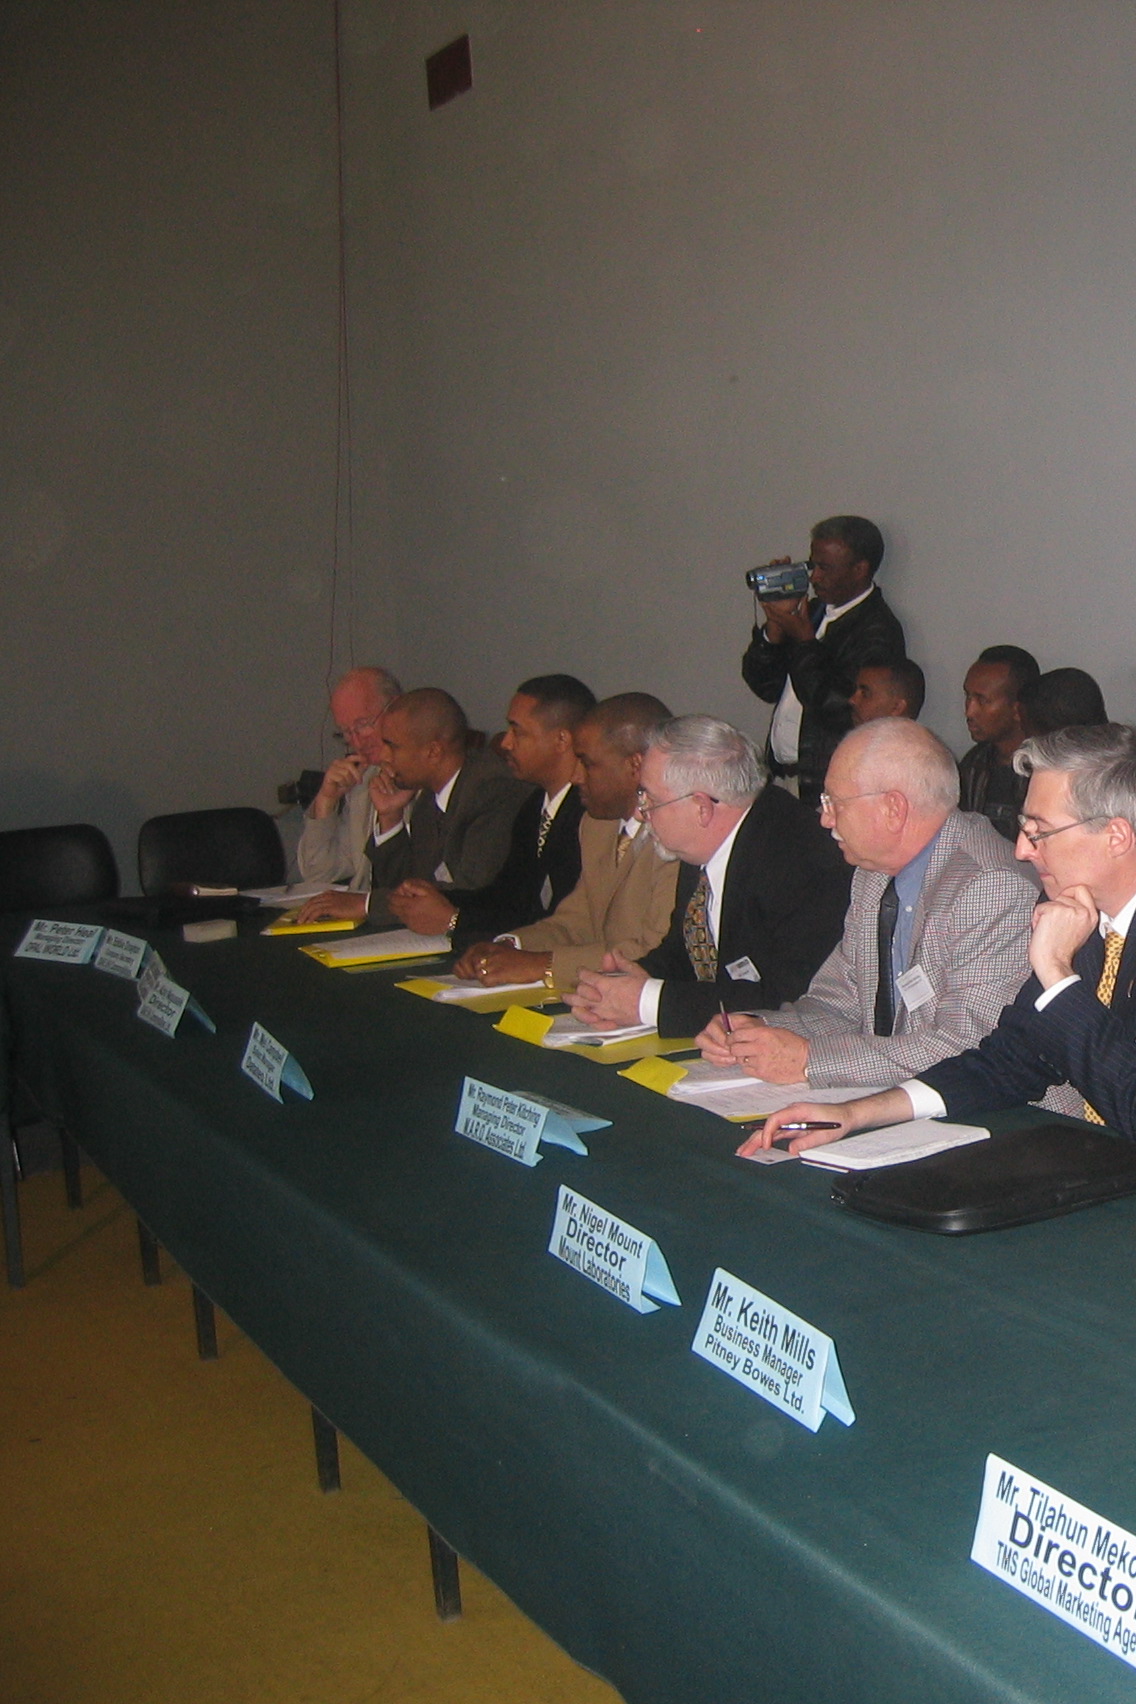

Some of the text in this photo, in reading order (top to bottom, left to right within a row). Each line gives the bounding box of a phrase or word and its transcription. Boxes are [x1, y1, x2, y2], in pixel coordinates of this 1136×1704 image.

[472, 1103, 526, 1136] Managing Director
[477, 1086, 504, 1110] Raymond
[502, 1096, 518, 1114] Peter
[517, 1102, 541, 1128] Kitching
[485, 1127, 515, 1155] Associates
[562, 1193, 643, 1259] Mr. Nigel Mount
[566, 1218, 627, 1271] Director
[559, 1235, 631, 1302] Mount Laboratories
[711, 1282, 816, 1370] Mr. Keith Mills
[713, 1315, 803, 1387] Business Manager
[704, 1334, 805, 1414] Pitney Bowes Ltd.
[995, 1470, 1020, 1506] Mr.
[1027, 1487, 1088, 1549] Tilahun
[997, 1541, 1019, 1576] TMS
[1020, 1557, 1054, 1598] Global
[1055, 1580, 1112, 1644] Marketing
